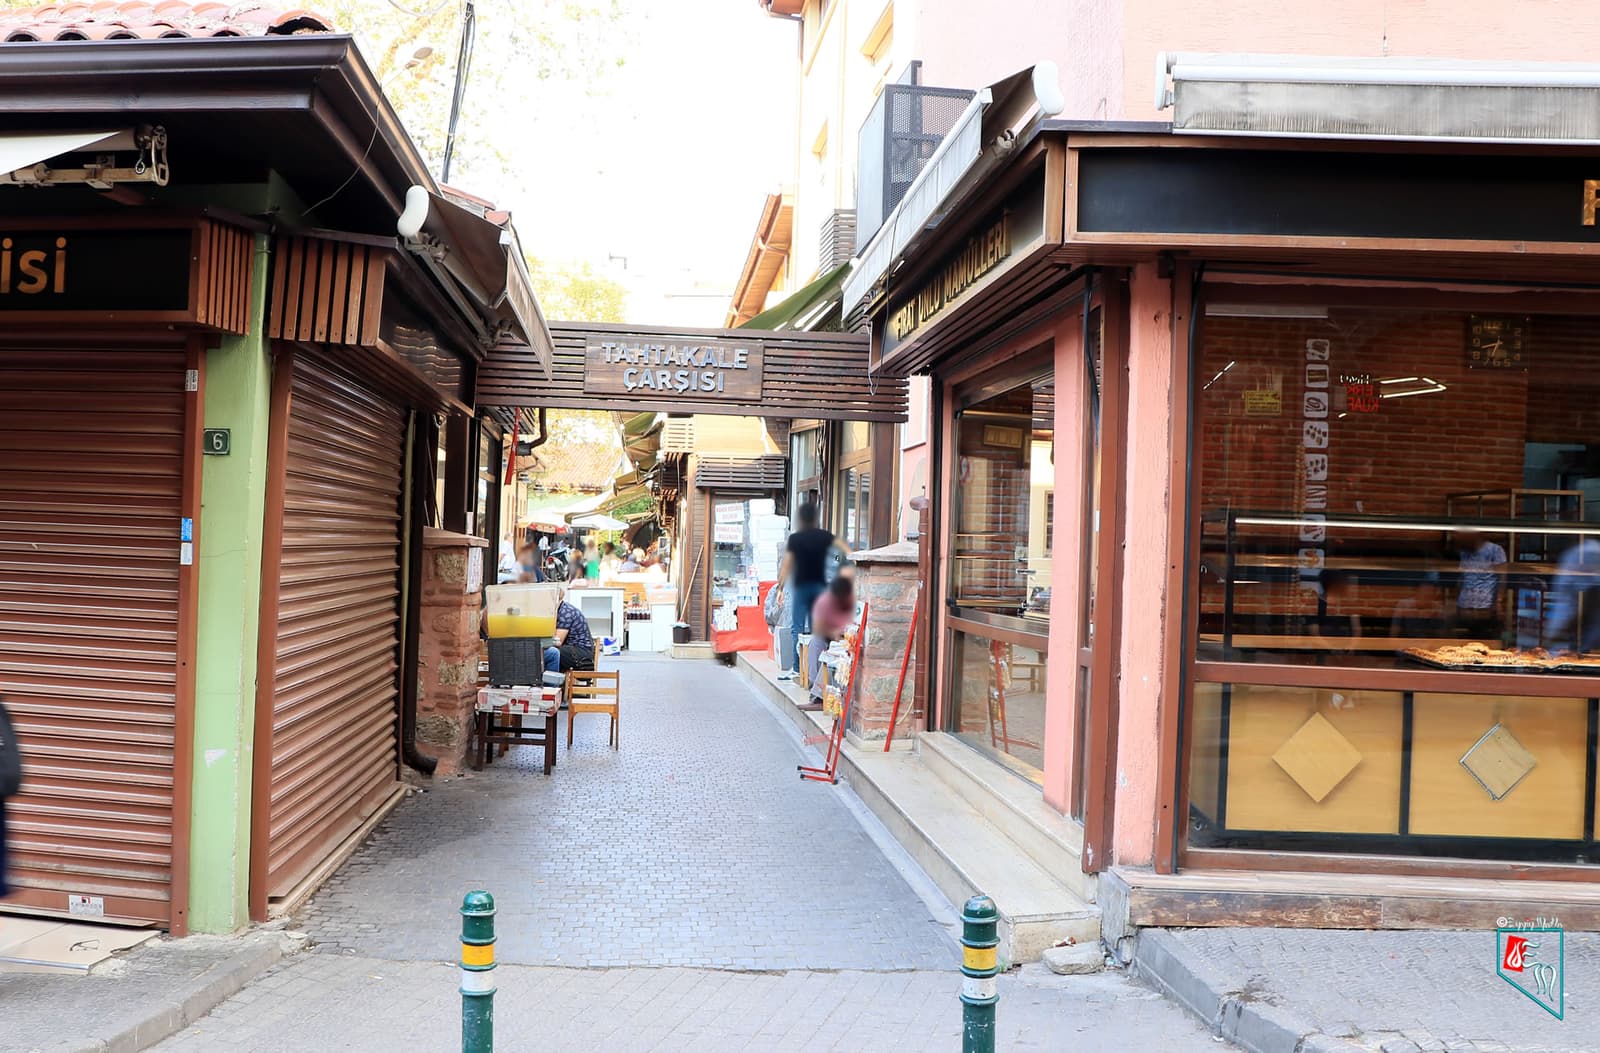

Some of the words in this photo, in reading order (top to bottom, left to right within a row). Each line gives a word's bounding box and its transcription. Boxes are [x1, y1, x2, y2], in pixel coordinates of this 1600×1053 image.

[602, 342, 749, 369] TAHTAKALE
[623, 368, 725, 393] ÇARŞISI
[213, 433, 223, 450] 6
